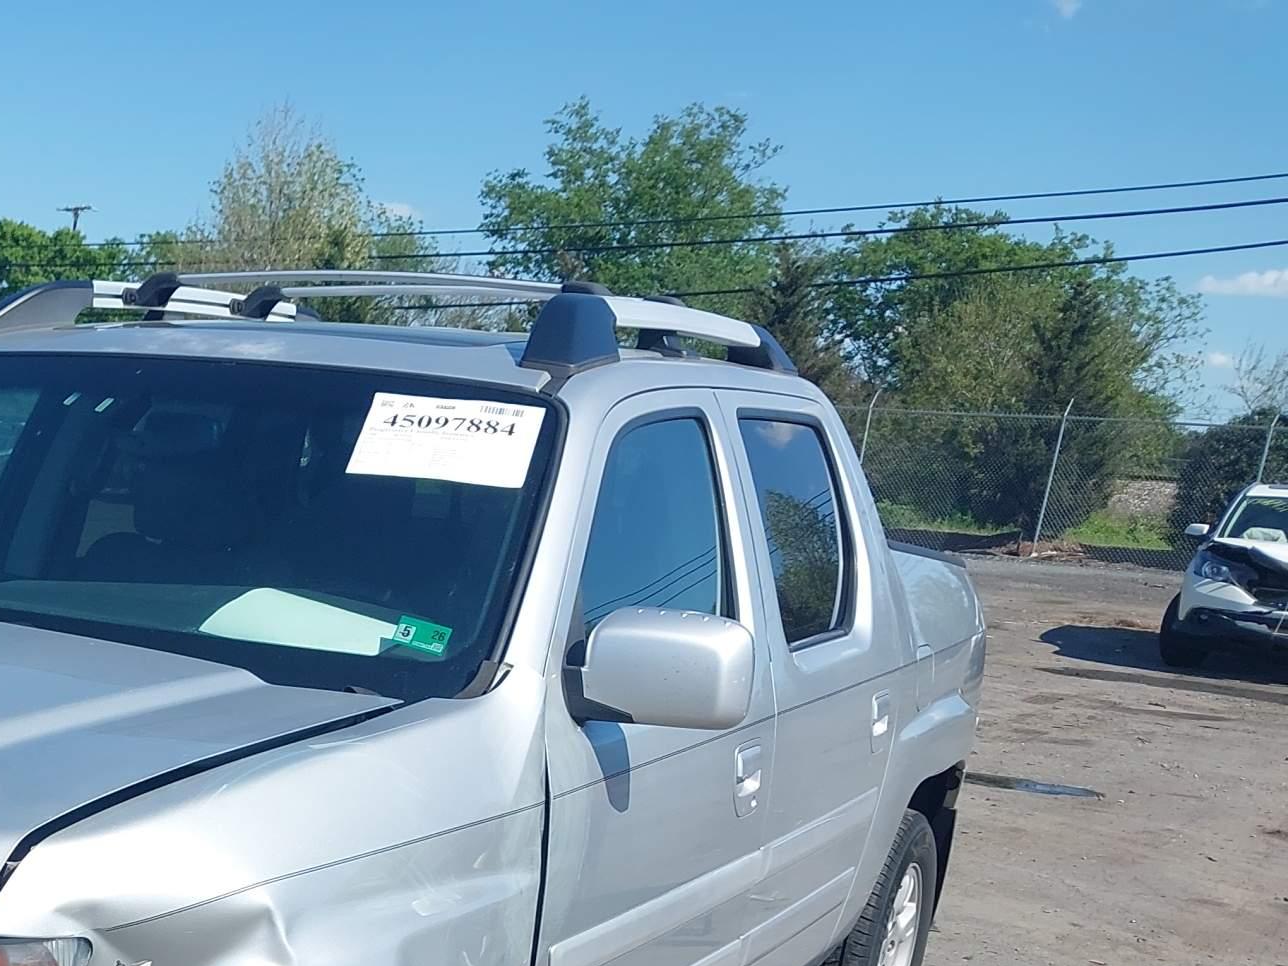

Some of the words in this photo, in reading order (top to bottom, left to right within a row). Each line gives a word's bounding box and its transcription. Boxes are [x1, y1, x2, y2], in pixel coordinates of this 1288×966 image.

[383, 413, 516, 436] 45097884
[399, 625, 412, 638] 5
[431, 630, 447, 642] 26
